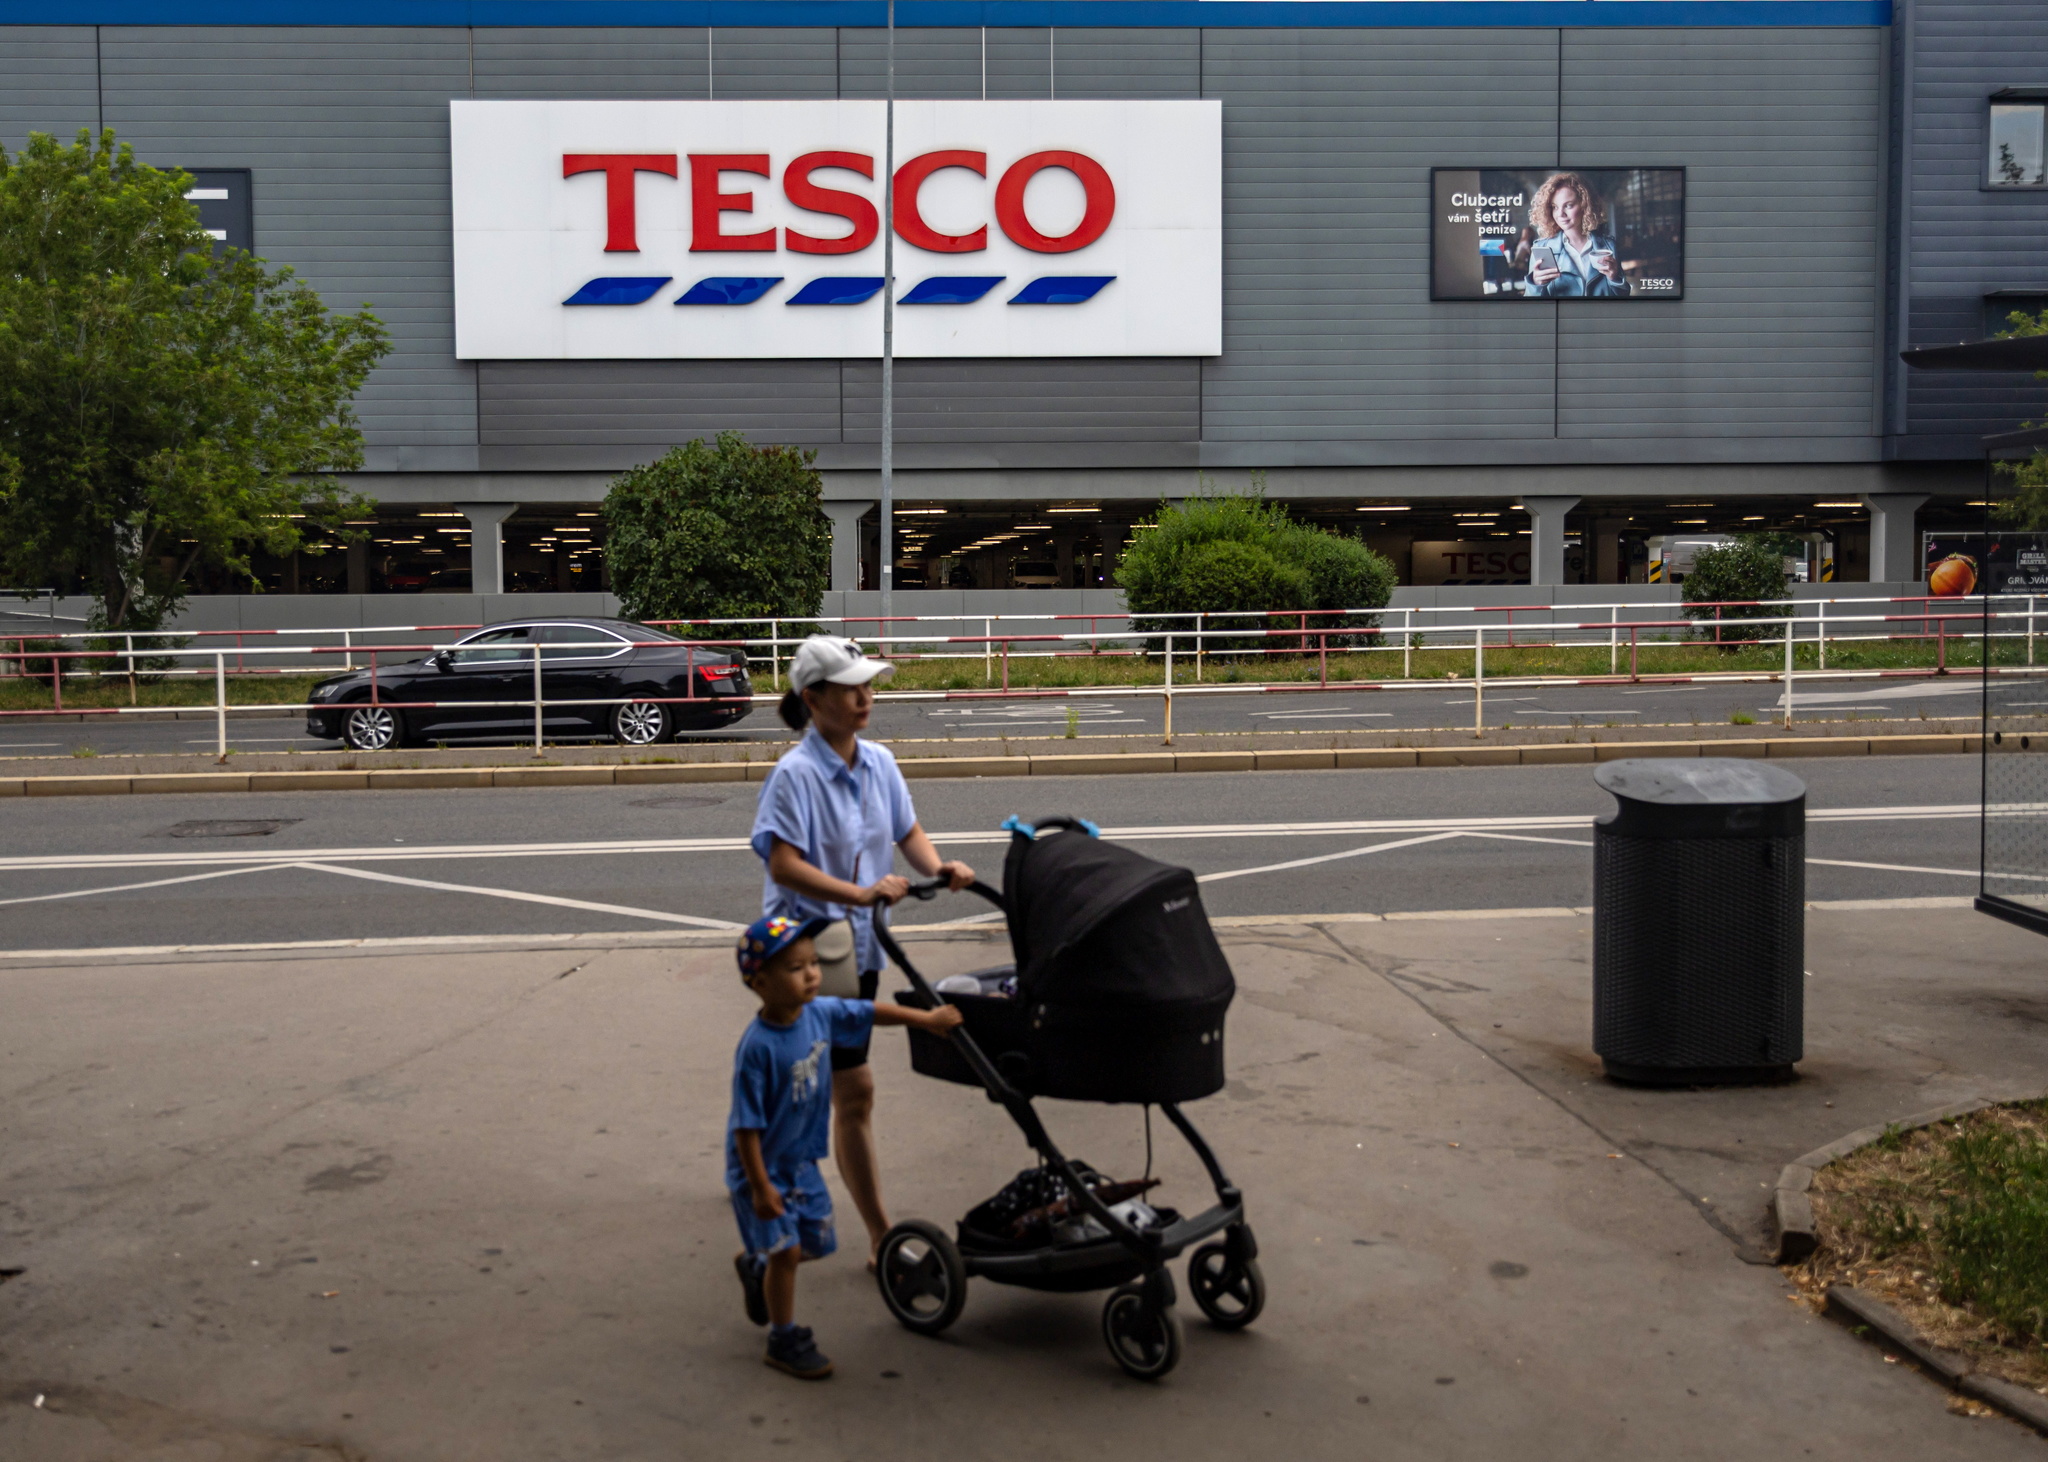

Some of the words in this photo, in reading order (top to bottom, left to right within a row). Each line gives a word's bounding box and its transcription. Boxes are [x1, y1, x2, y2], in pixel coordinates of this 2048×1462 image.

[562, 149, 1116, 256] TESCO
[1451, 193, 1523, 207] Clubcard
[1447, 213, 1470, 223] vám
[1474, 208, 1510, 223] šetří
[1478, 224, 1517, 237] peníze
[1640, 278, 1674, 287] TESCO
[1441, 552, 1531, 575] TESC
